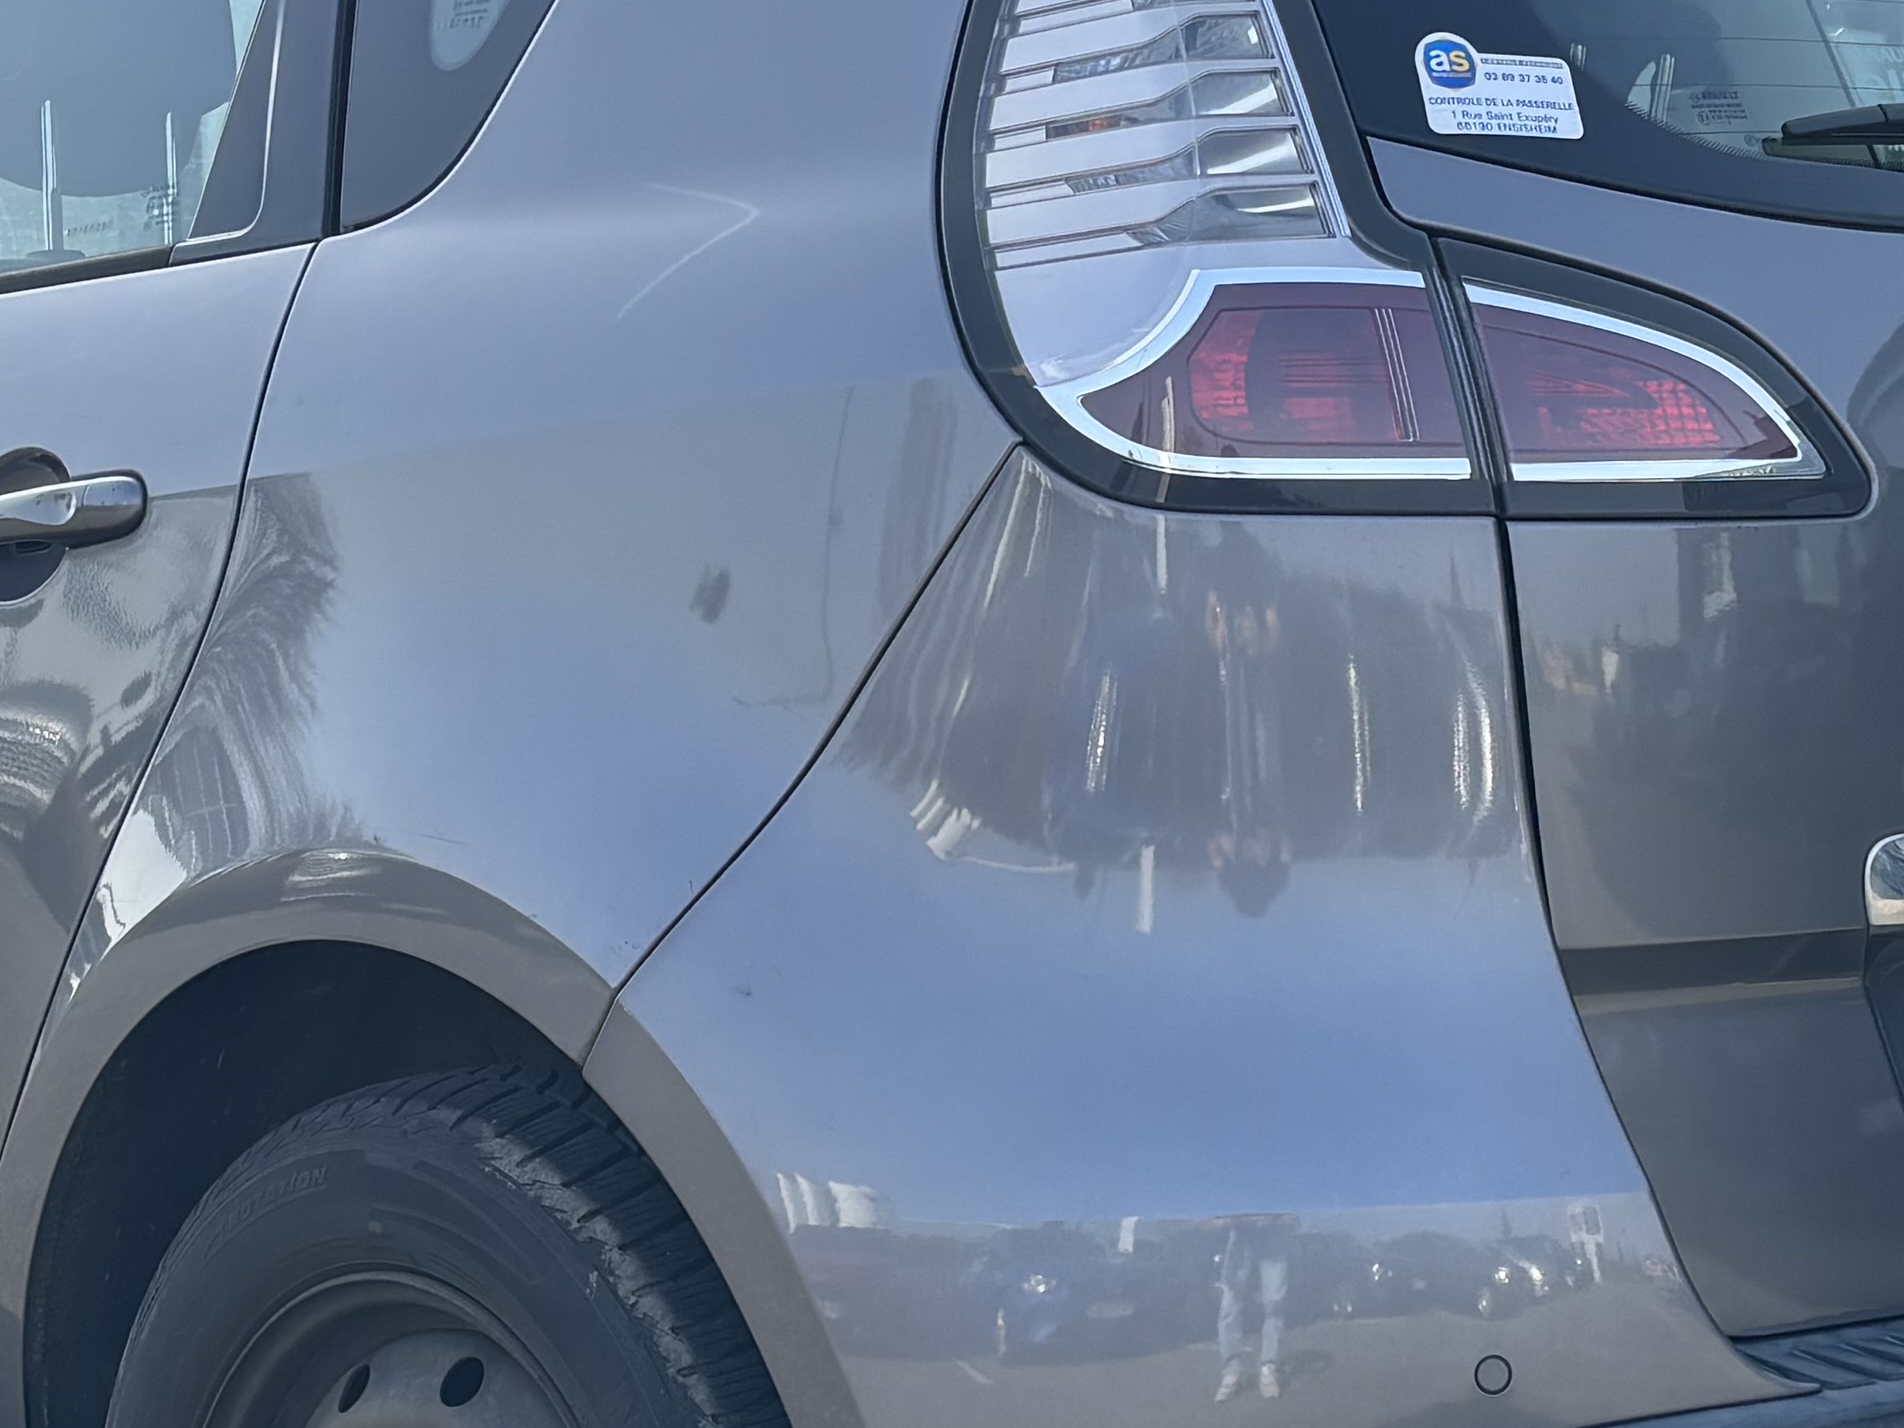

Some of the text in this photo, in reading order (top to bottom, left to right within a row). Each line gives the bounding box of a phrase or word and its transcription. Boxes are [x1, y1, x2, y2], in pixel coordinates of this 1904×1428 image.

[1429, 49, 1471, 73] as
[1485, 98, 1498, 107] DE
[1501, 99, 1513, 107] LA
